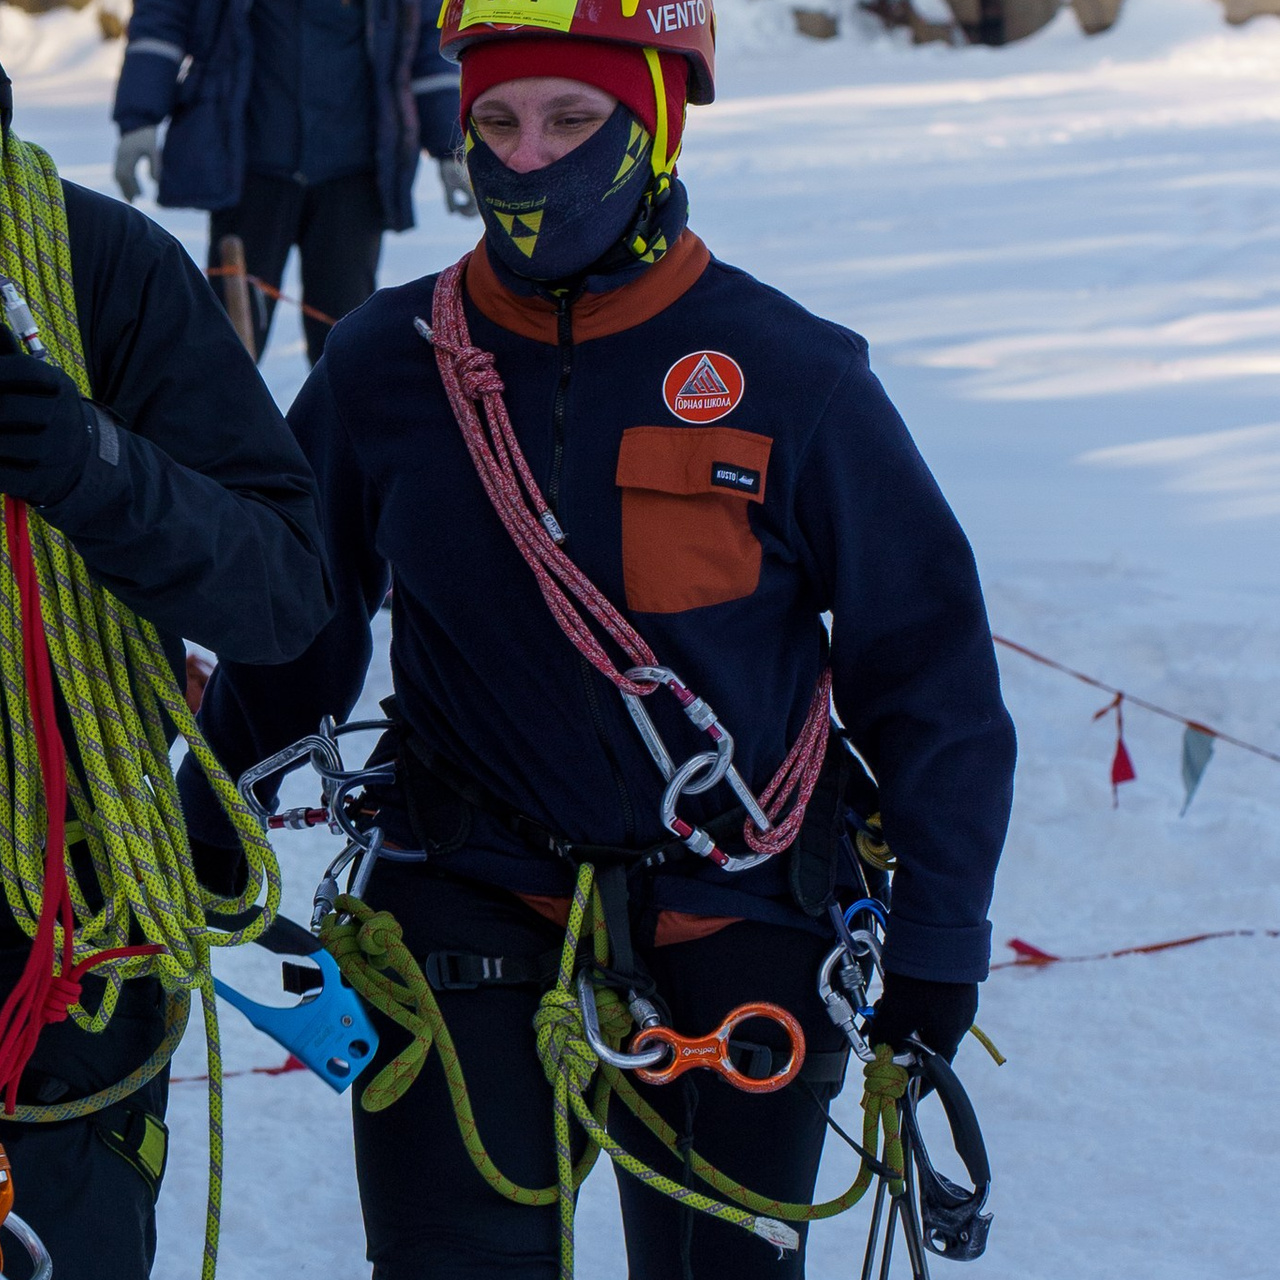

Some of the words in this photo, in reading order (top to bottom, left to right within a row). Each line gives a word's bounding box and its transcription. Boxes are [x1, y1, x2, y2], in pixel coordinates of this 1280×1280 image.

[647, 0, 706, 34] VENTO
[485, 195, 547, 210] FISCHER
[716, 470, 736, 482] KUSTO
